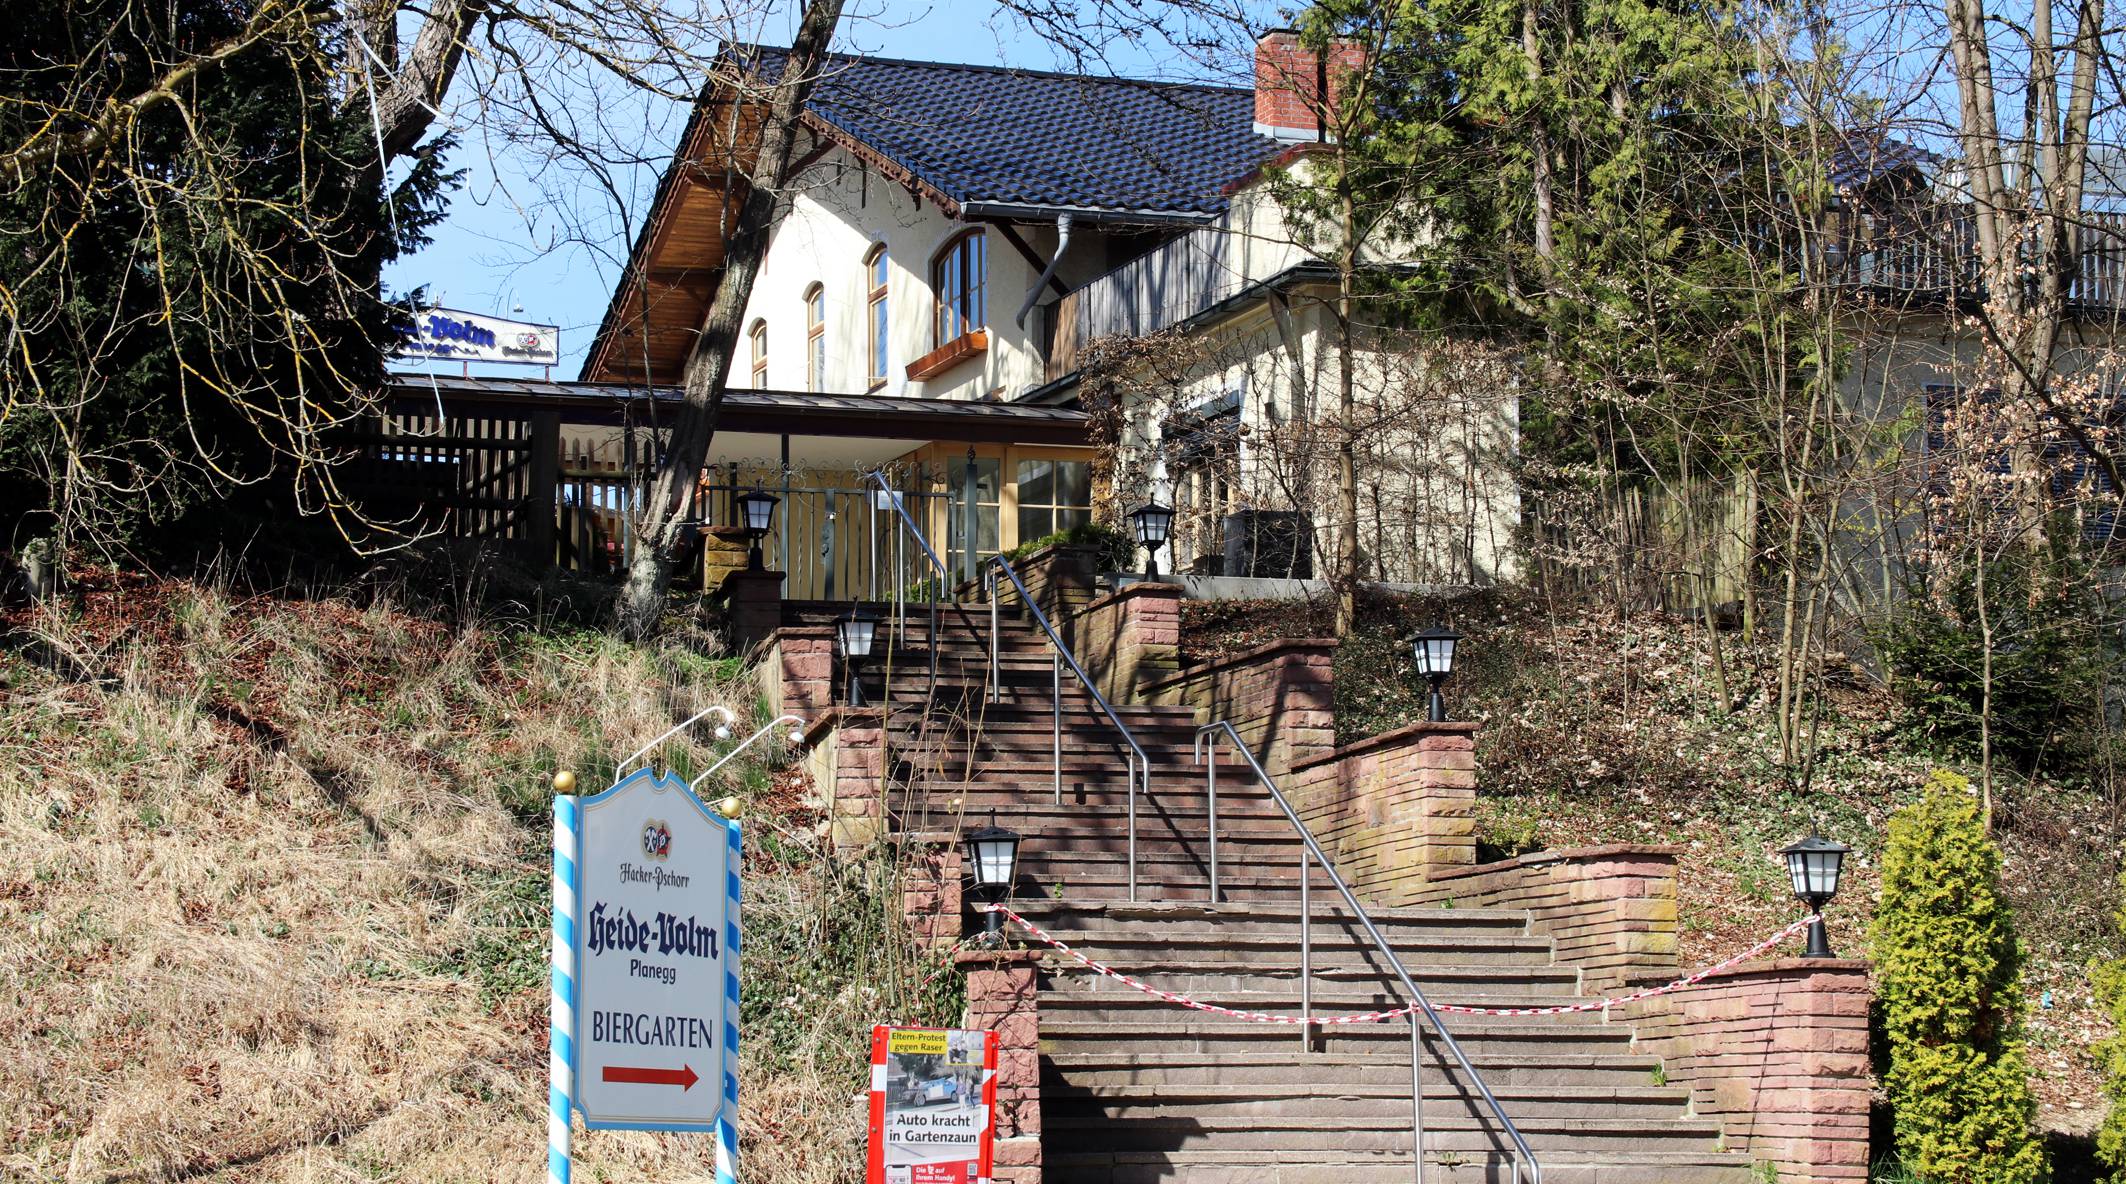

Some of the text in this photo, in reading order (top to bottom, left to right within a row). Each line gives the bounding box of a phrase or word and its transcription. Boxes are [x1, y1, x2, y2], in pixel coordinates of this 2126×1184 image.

[620, 863, 690, 891] Hacker-Pschorr
[588, 901, 718, 960] Heide-Volm
[630, 959, 676, 985] Planegg
[593, 1010, 712, 1049] BIERGARTEN
[891, 1032, 946, 1042] Eltern-Protest
[895, 1043, 943, 1052] gegen Raser
[897, 1114, 971, 1127] Auto kracht
[889, 1129, 976, 1143] in Gartenzaun
